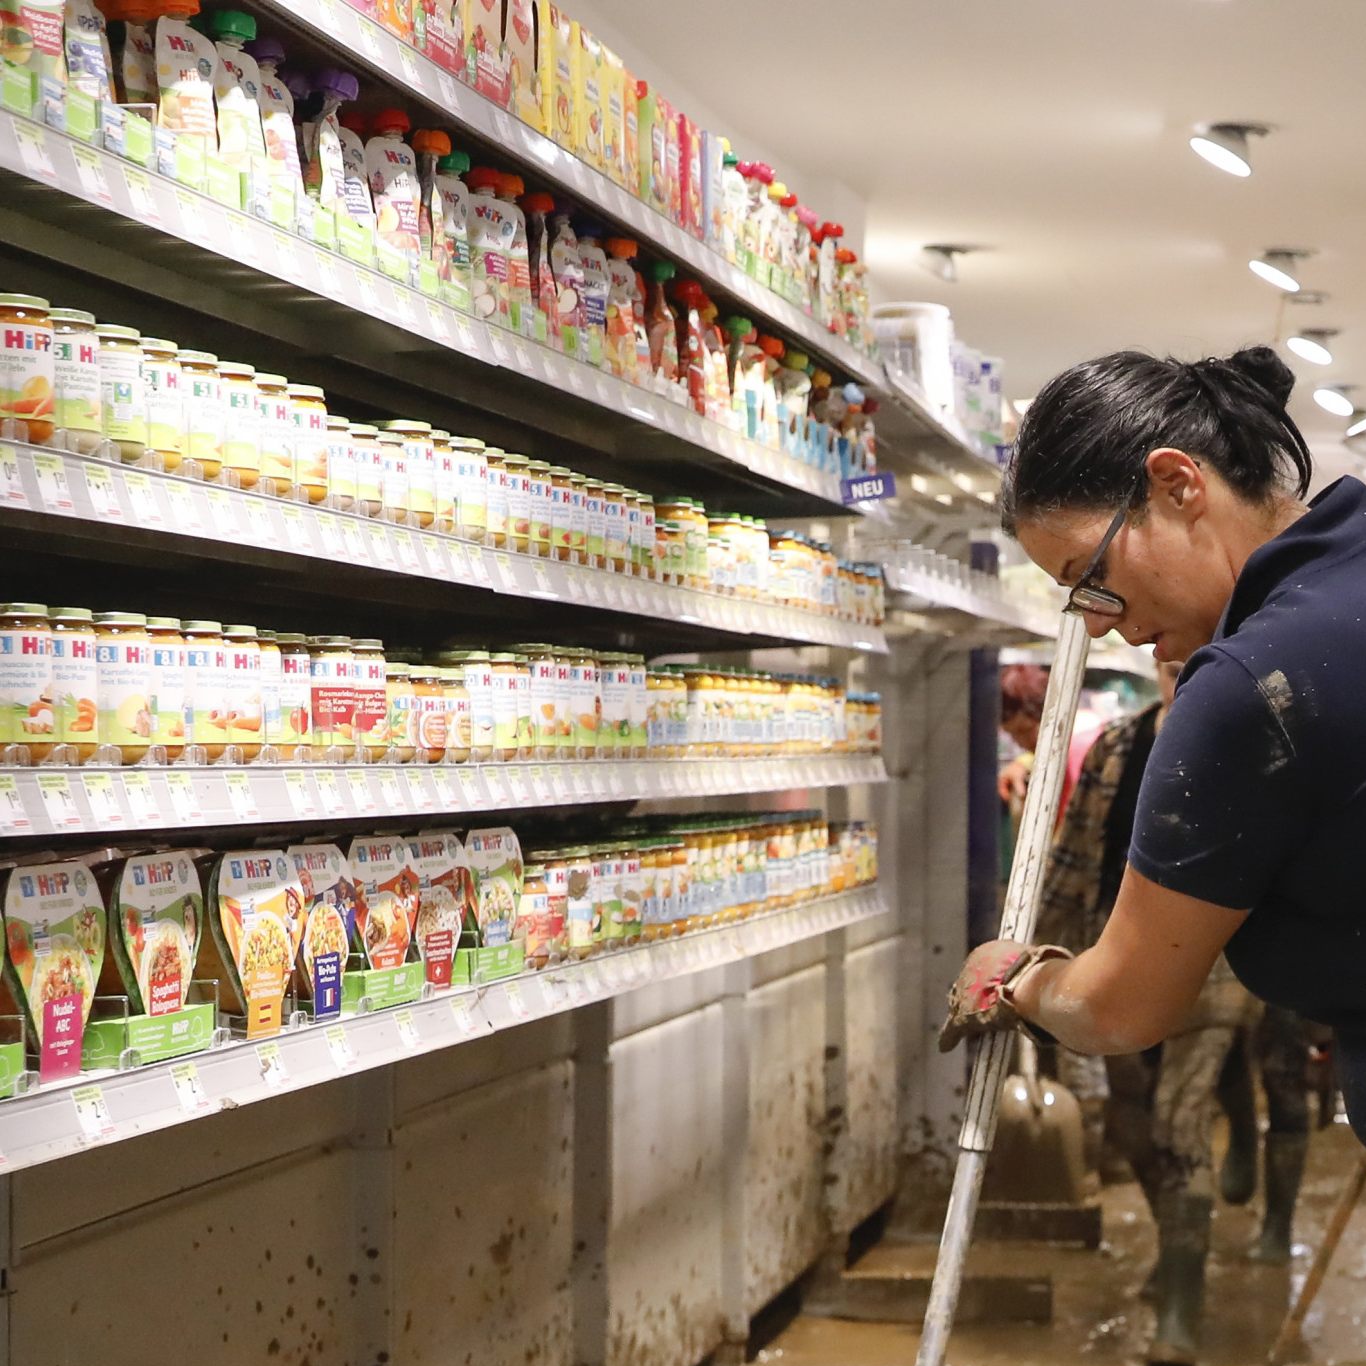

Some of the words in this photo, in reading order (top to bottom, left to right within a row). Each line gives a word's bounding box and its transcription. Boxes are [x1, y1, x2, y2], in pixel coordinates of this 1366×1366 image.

[851, 479, 884, 499] NEU
[22, 636, 52, 656] HiP
[147, 860, 174, 884] HiPP
[244, 859, 272, 878] HiPP
[37, 872, 70, 897] HiPP
[53, 1002, 76, 1018] Nudel-
[56, 1018, 72, 1033] ABC
